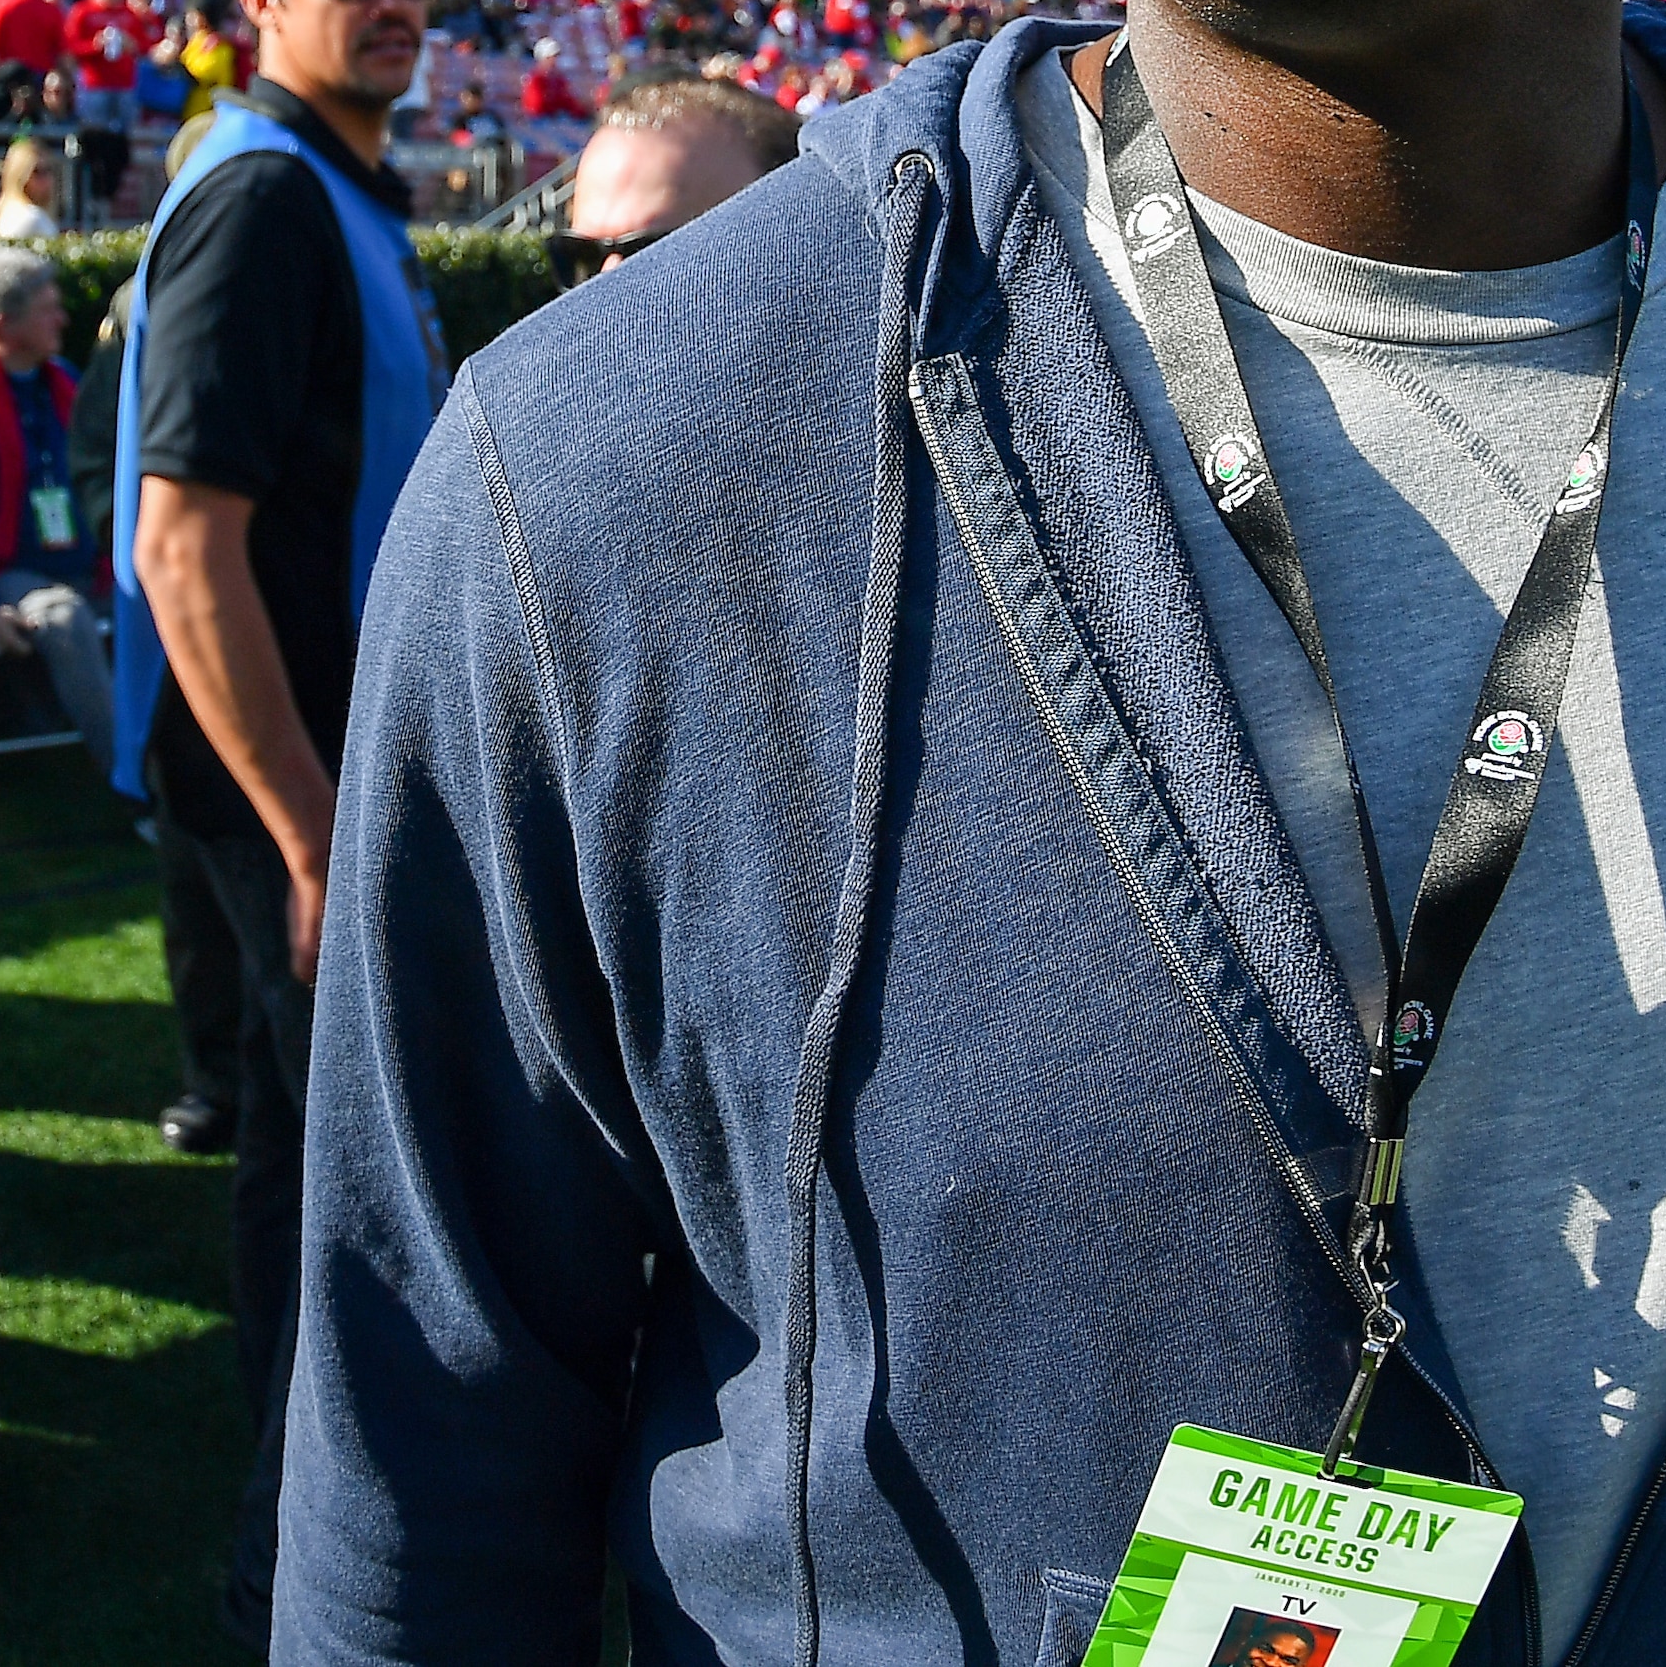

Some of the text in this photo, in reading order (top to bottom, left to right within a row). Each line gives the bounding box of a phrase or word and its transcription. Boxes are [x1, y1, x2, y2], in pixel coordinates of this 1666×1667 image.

[1209, 1469, 1456, 1553] GAME DAY
[1250, 1525, 1379, 1573] ACCESS
[1255, 1572, 1301, 1589] JANUARY
[1318, 1586, 1346, 1599] 2020
[1281, 1594, 1318, 1615] TV
